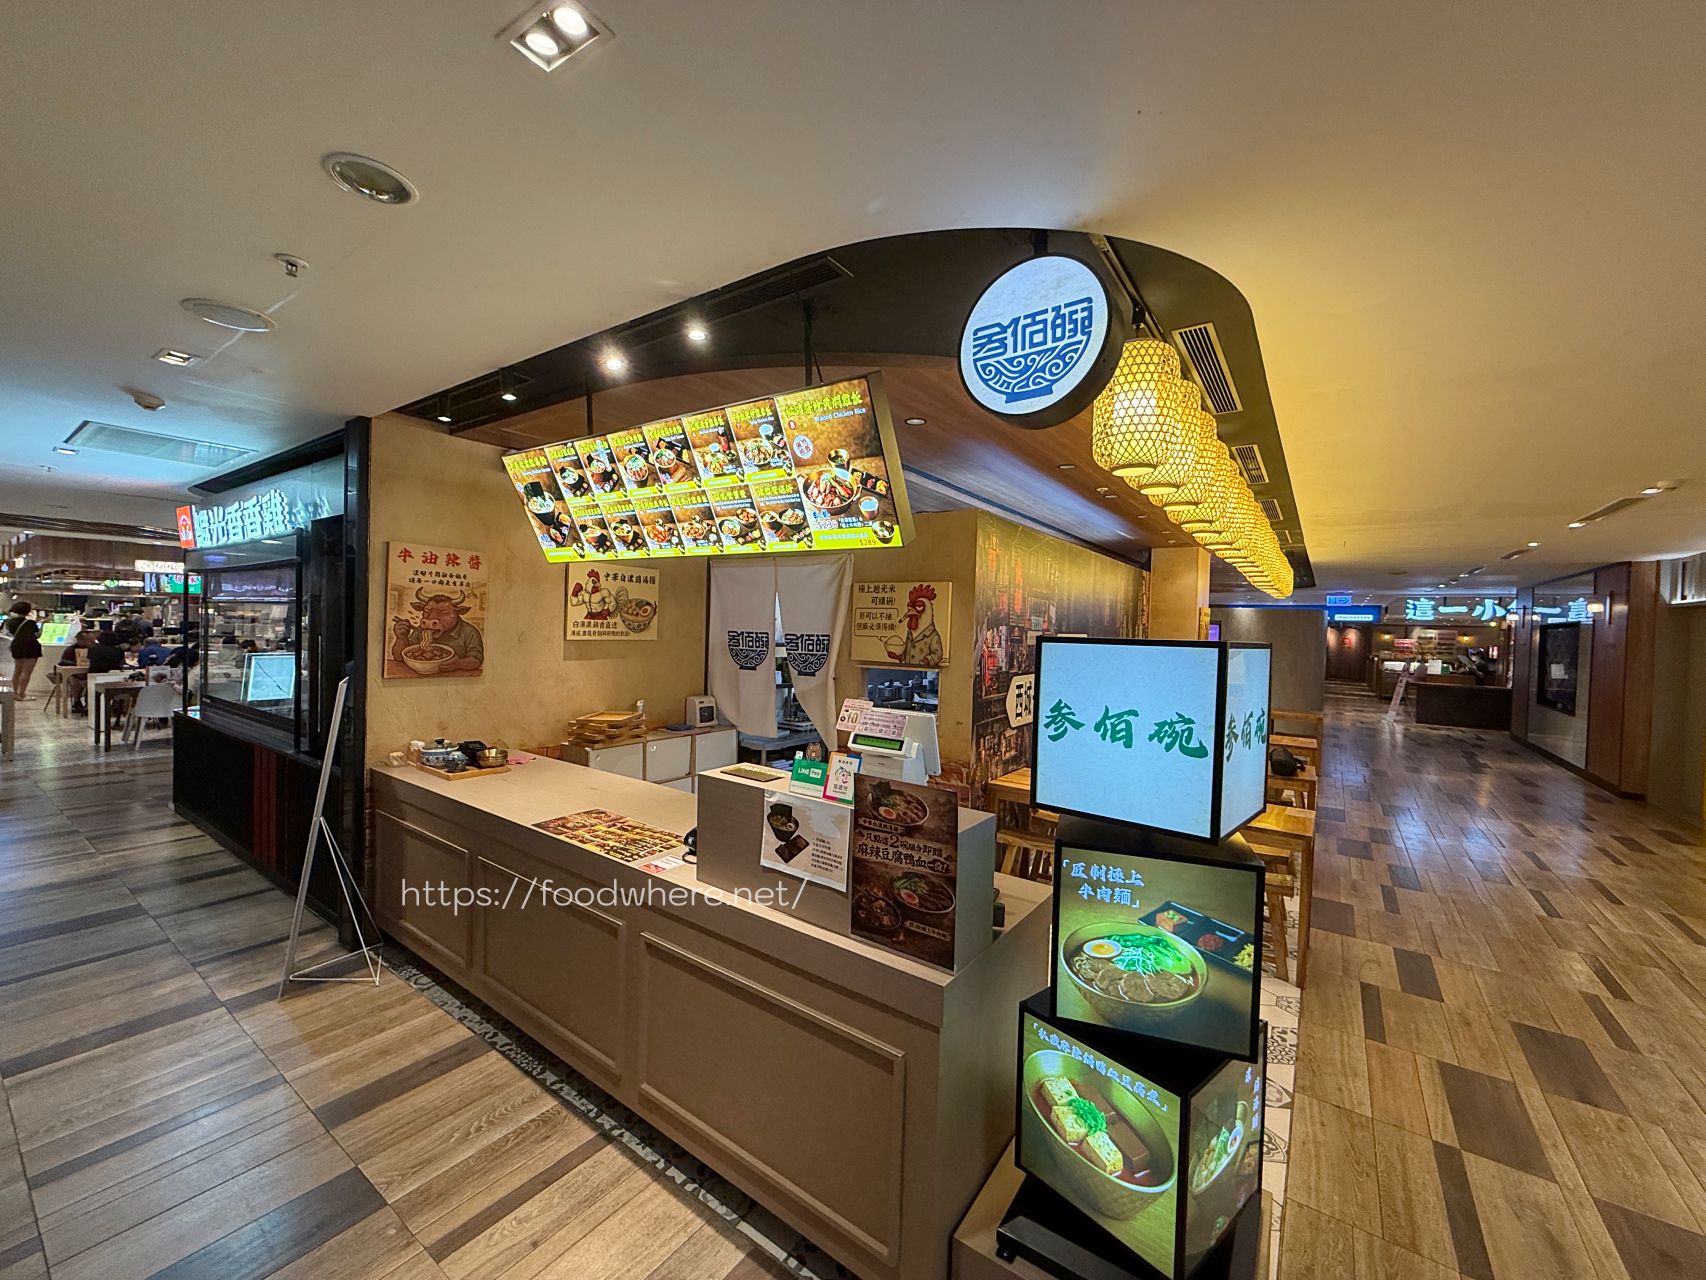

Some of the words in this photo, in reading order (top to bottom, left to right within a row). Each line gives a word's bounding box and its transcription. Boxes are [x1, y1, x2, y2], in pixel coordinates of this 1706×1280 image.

[834, 409, 854, 420] Chicken
[855, 406, 867, 416] Rice
[858, 584, 896, 594] 極上越光米
[797, 766, 810, 776] LINE
